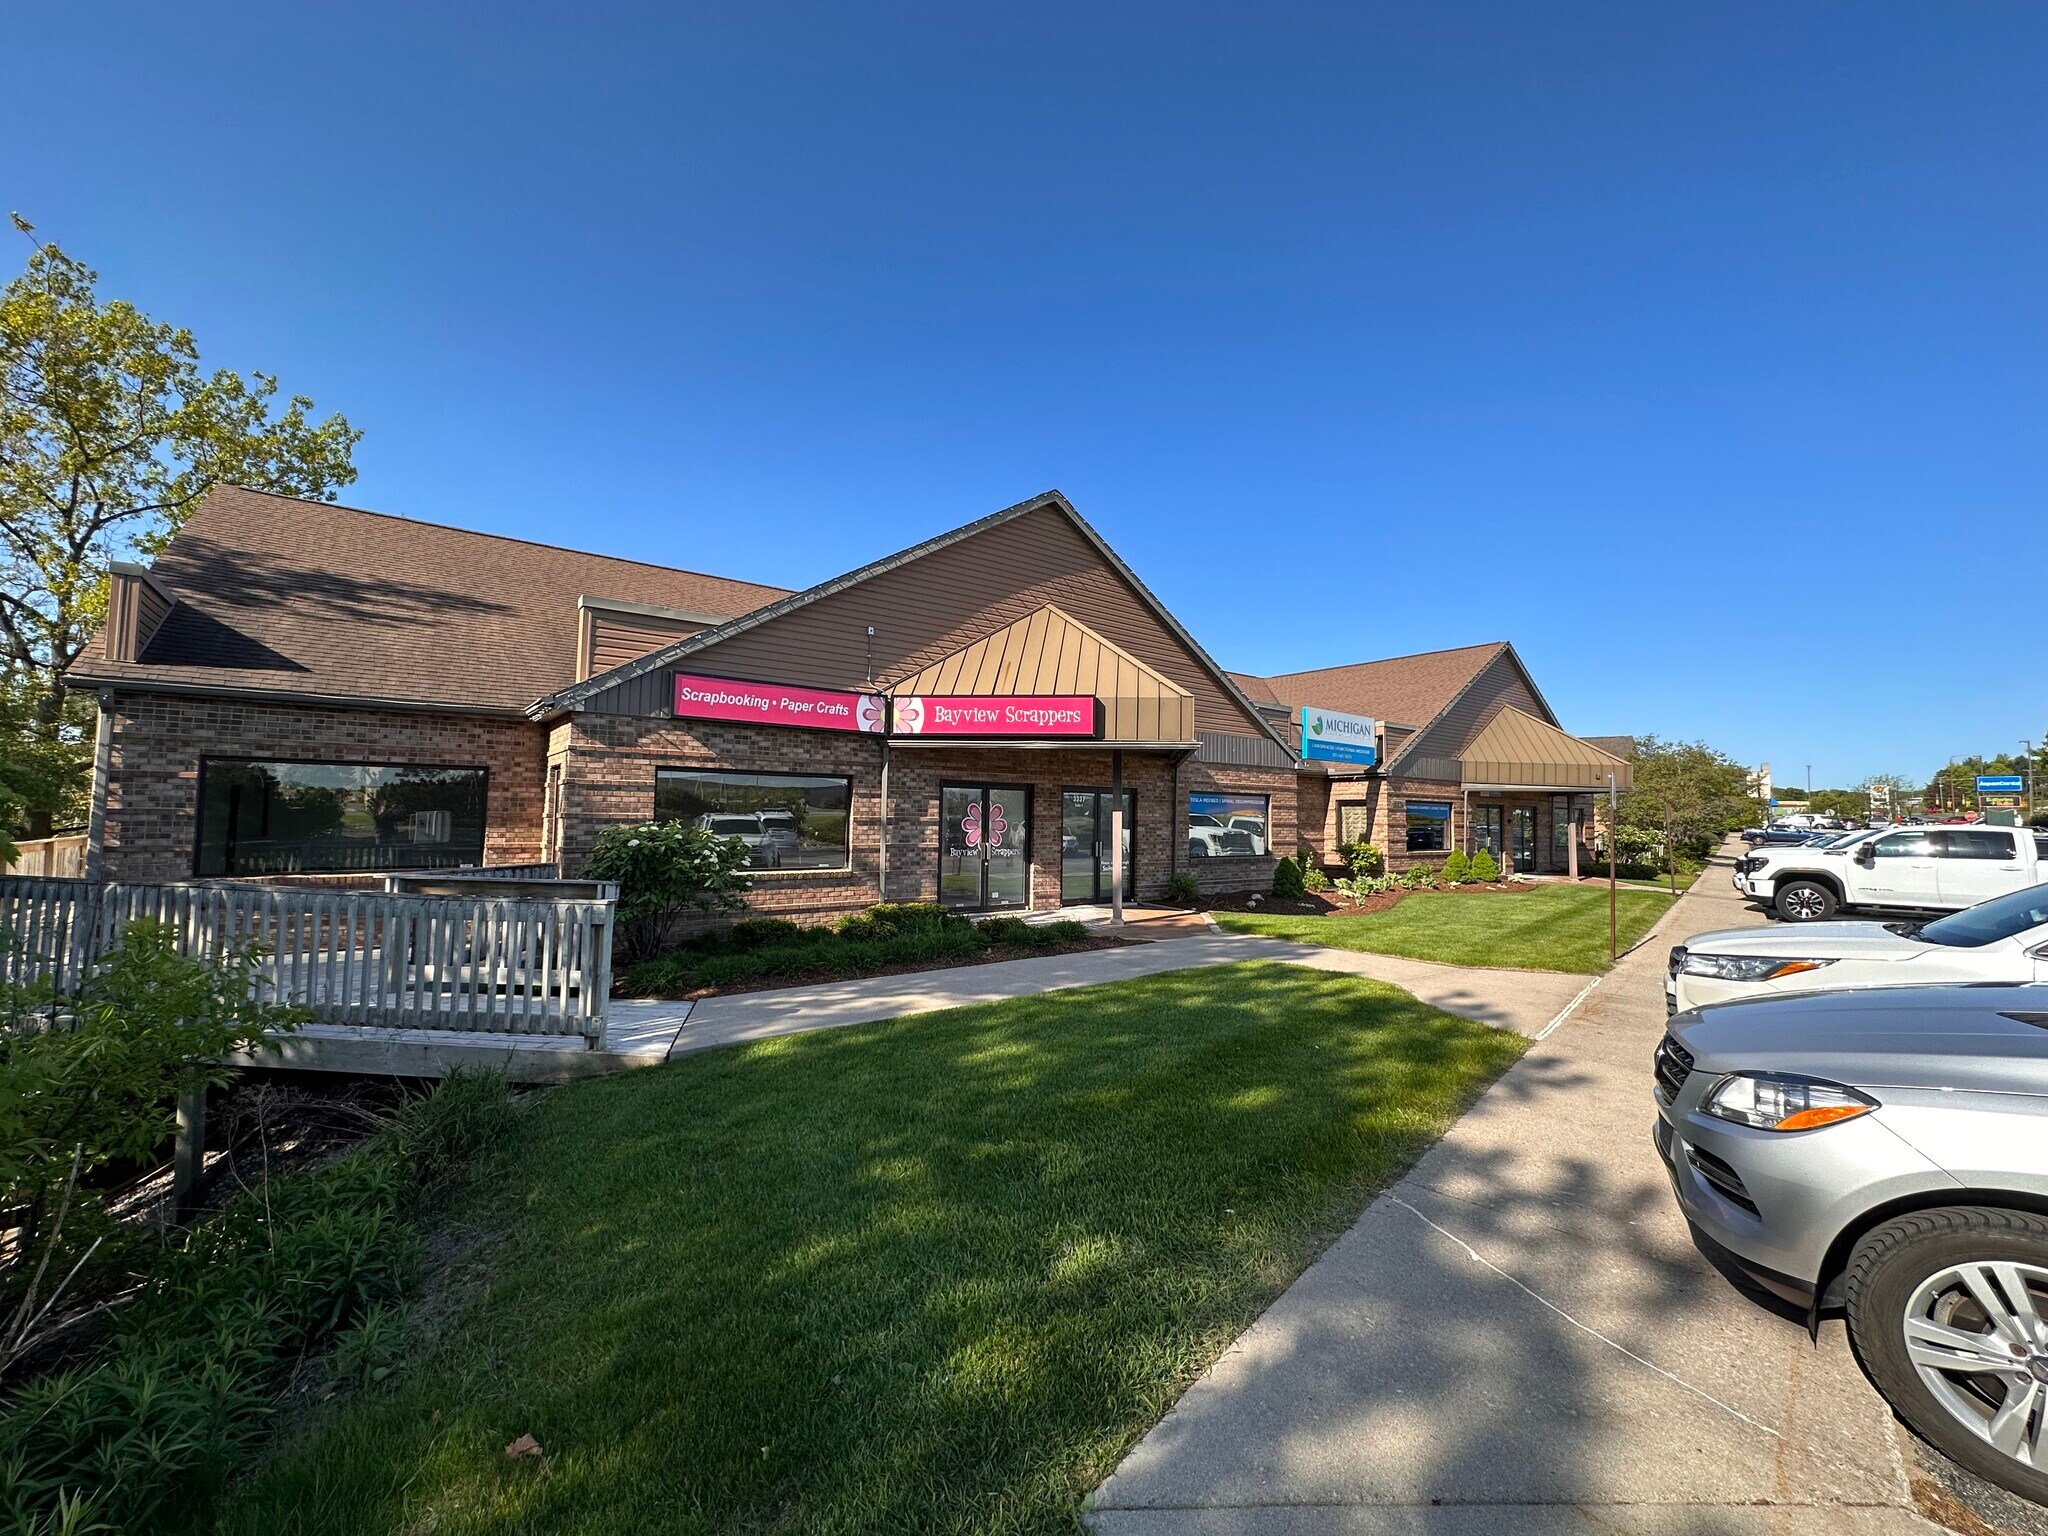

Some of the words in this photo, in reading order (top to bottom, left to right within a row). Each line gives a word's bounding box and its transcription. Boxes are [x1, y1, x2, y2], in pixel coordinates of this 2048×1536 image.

[681, 687, 769, 711] Scrapbooking
[780, 697, 814, 713] Paper
[816, 701, 849, 716] Crafts
[934, 705, 1000, 726] Bayview
[1005, 705, 1081, 726] Scrappers
[1325, 718, 1371, 736] MICHIGAN
[950, 847, 979, 858] Bayview
[991, 847, 1021, 857] Scrappers
